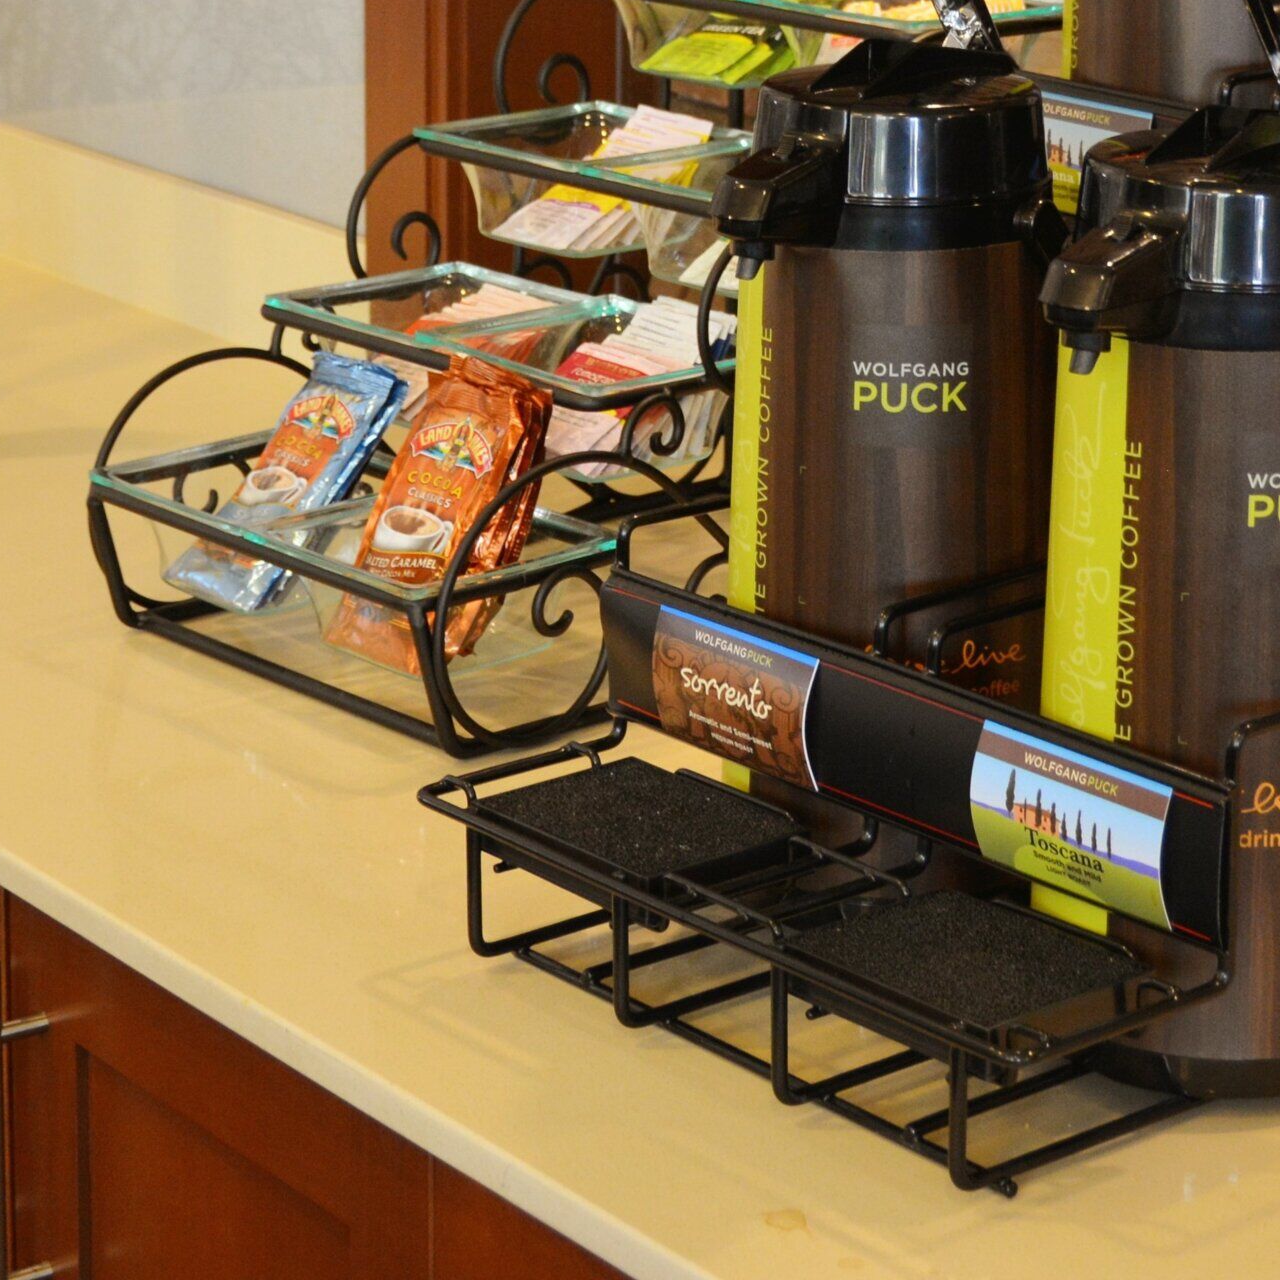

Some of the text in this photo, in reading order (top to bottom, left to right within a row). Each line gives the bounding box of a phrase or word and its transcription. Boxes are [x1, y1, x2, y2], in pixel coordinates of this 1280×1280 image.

[758, 326, 774, 444] COFFEE
[853, 361, 969, 378] WOLFGANG
[853, 381, 968, 413] PUCK
[419, 425, 453, 446] LAND
[406, 470, 464, 500] COCOA
[1119, 440, 1143, 570] COFFEE
[755, 459, 769, 569] GROWN
[952, 639, 1026, 674] live
[1115, 597, 1138, 708] GROWN
[680, 667, 773, 720] sorrento
[1024, 826, 1105, 874] Toscana
